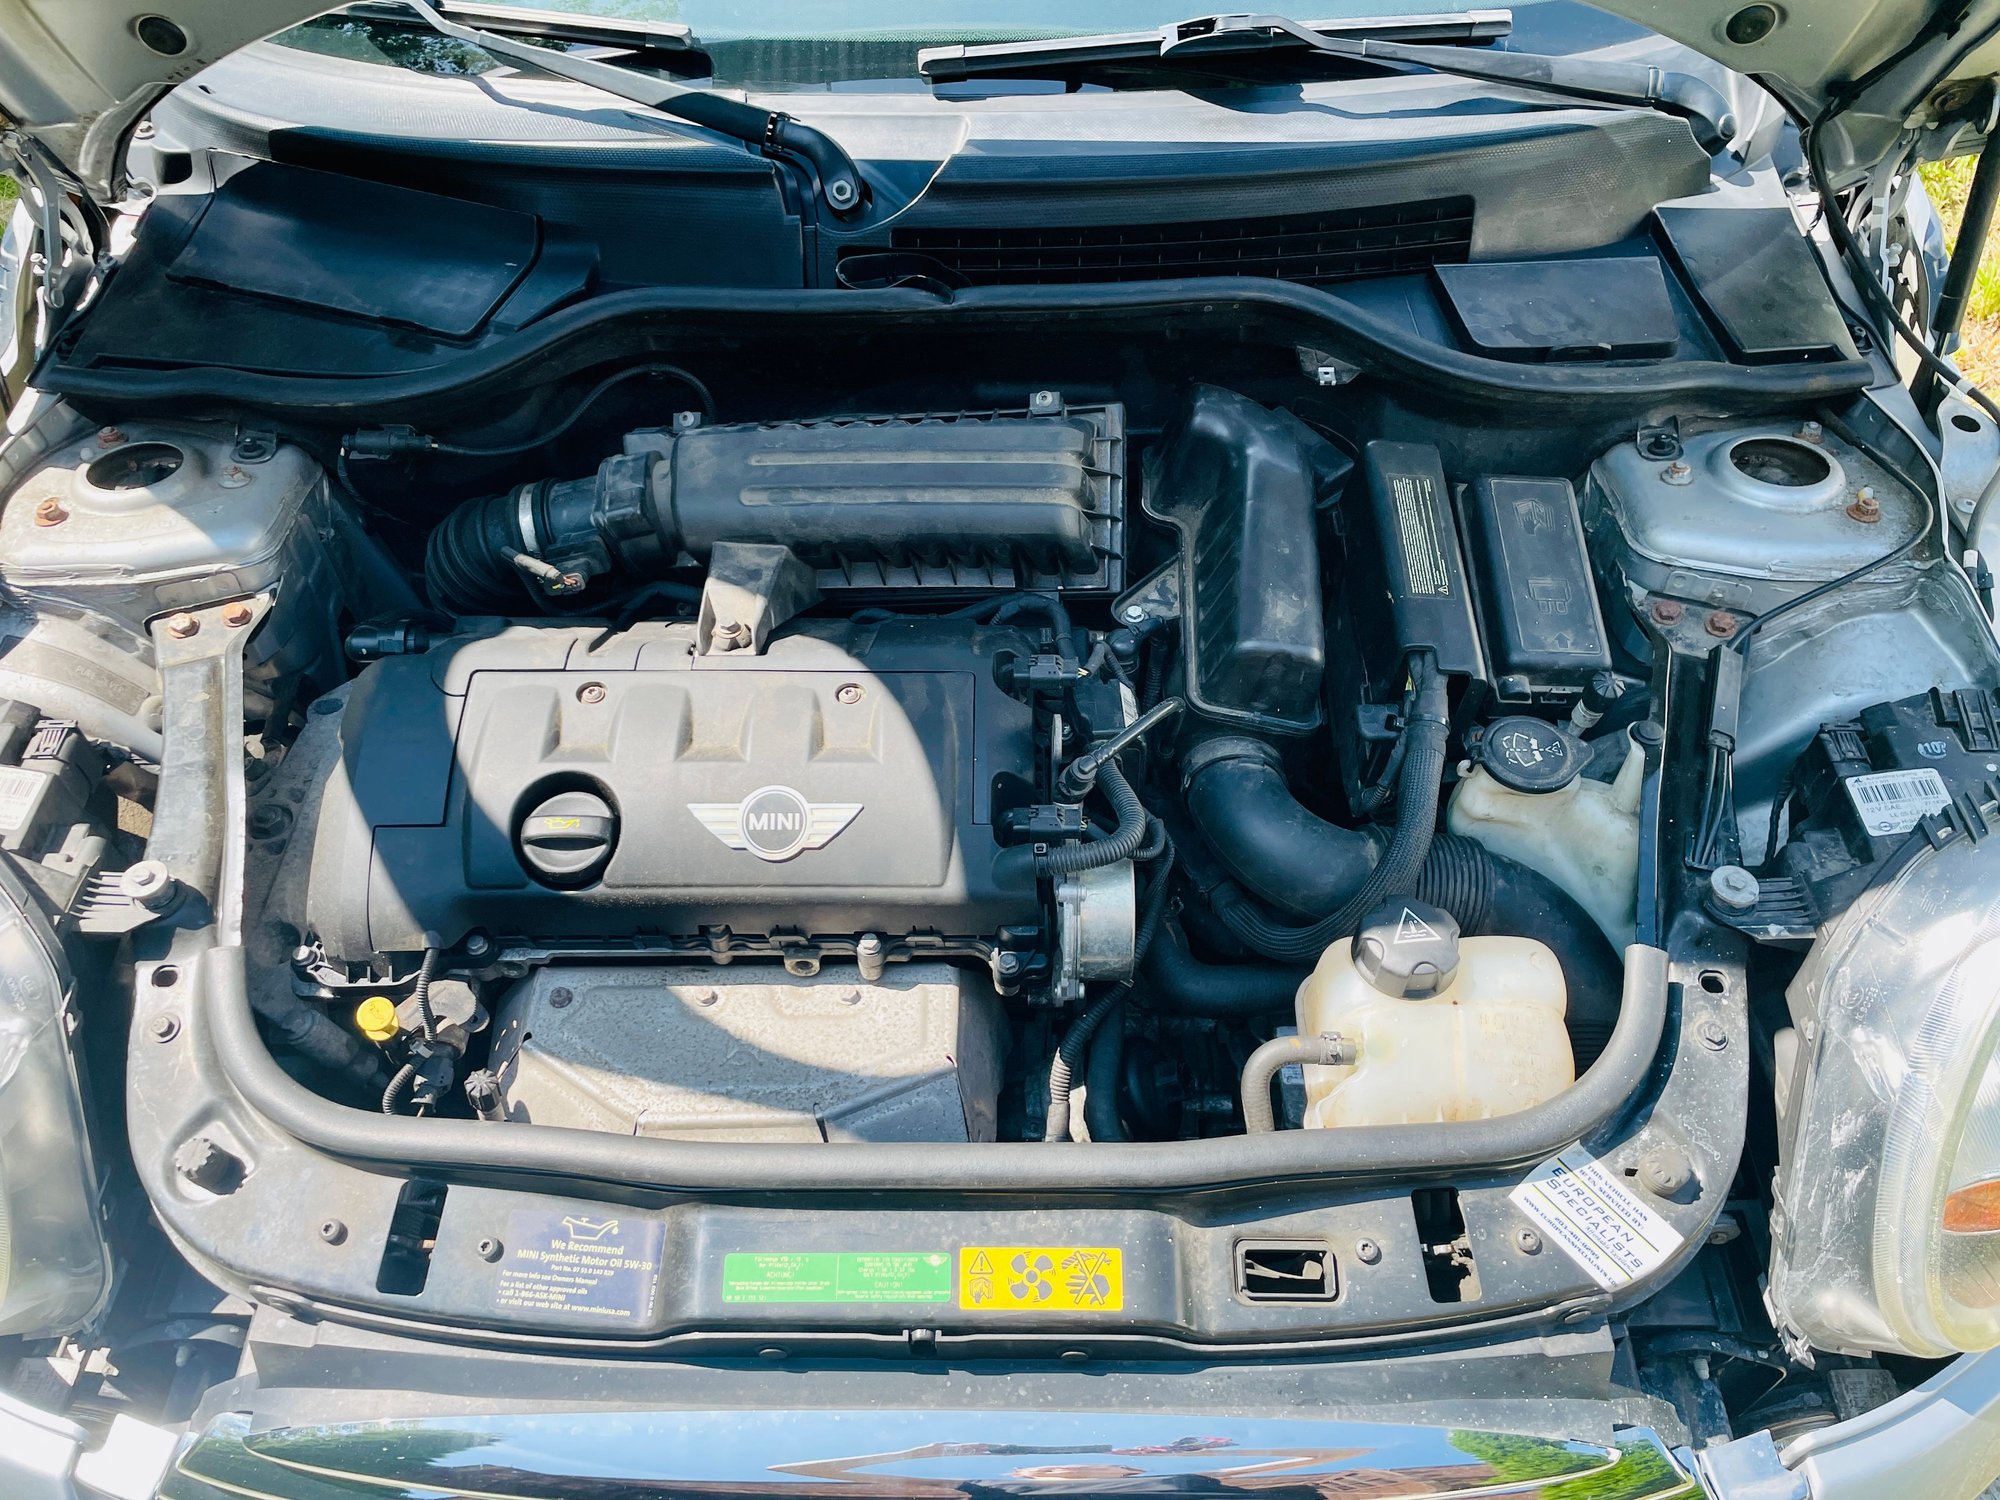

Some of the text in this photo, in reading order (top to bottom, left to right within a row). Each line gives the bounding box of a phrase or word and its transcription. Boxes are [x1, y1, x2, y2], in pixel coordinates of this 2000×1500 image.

[749, 813, 800, 830] MINI
[1588, 1165, 1648, 1222] THIS VEHICLE HAS
[1599, 1186, 1630, 1218] SERVICED
[1552, 1166, 1634, 1242] EUROPEAN
[1546, 1179, 1643, 1268] SPECIALISTS
[552, 1240, 624, 1255] We Recommend
[517, 1250, 652, 1270] MINI Synthetic Motor Oil 5W-30
[500, 1280, 509, 1288] For
[549, 1286, 576, 1295] approved
[529, 1272, 541, 1280] info
[552, 1274, 574, 1283] Owners
[575, 1276, 597, 1285] Manual
[508, 1298, 522, 1306] visit
[572, 1305, 630, 1316] www.miniusa.com
